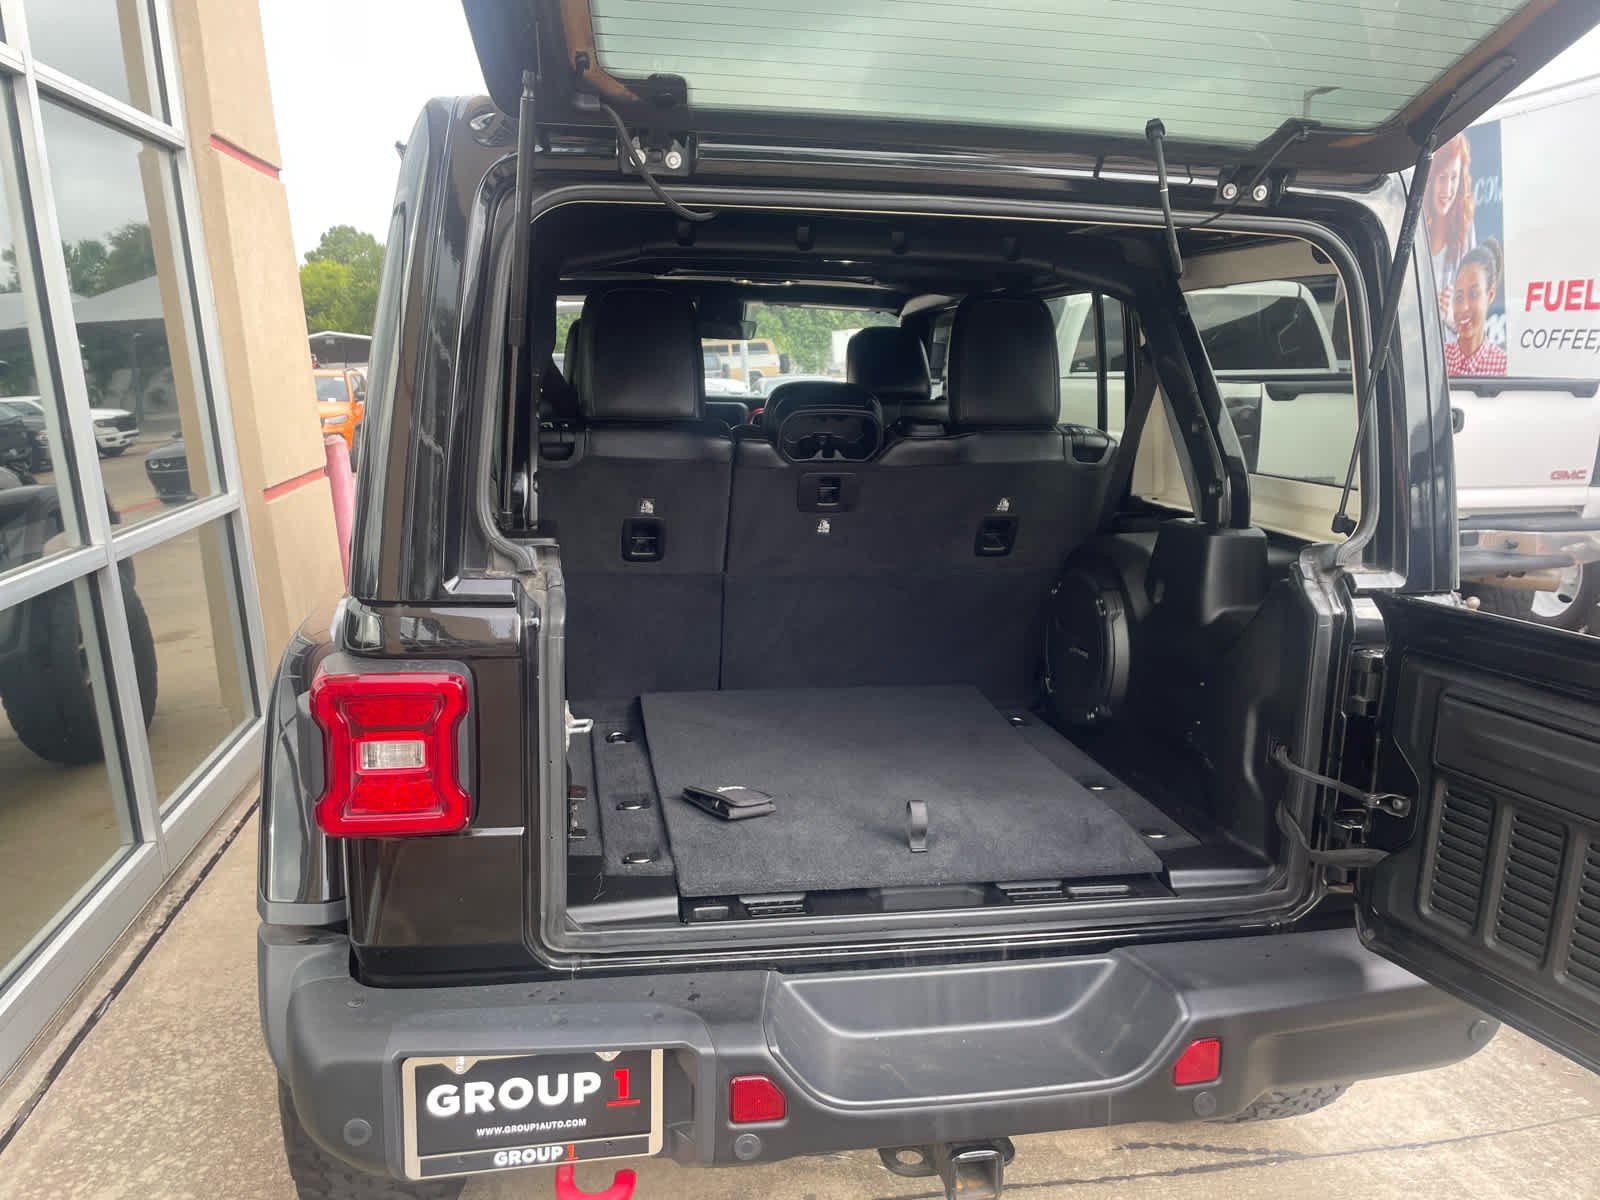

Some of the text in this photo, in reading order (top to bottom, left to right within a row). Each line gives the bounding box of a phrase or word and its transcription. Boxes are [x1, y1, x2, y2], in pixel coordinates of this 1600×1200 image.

[1525, 278, 1600, 312] FUEL
[1551, 469, 1586, 480] GMC
[426, 1068, 640, 1117] GROUP 1
[476, 1118, 587, 1136] WWW.GROUP1AUTO.COM
[493, 1143, 578, 1167] GROUP 1
